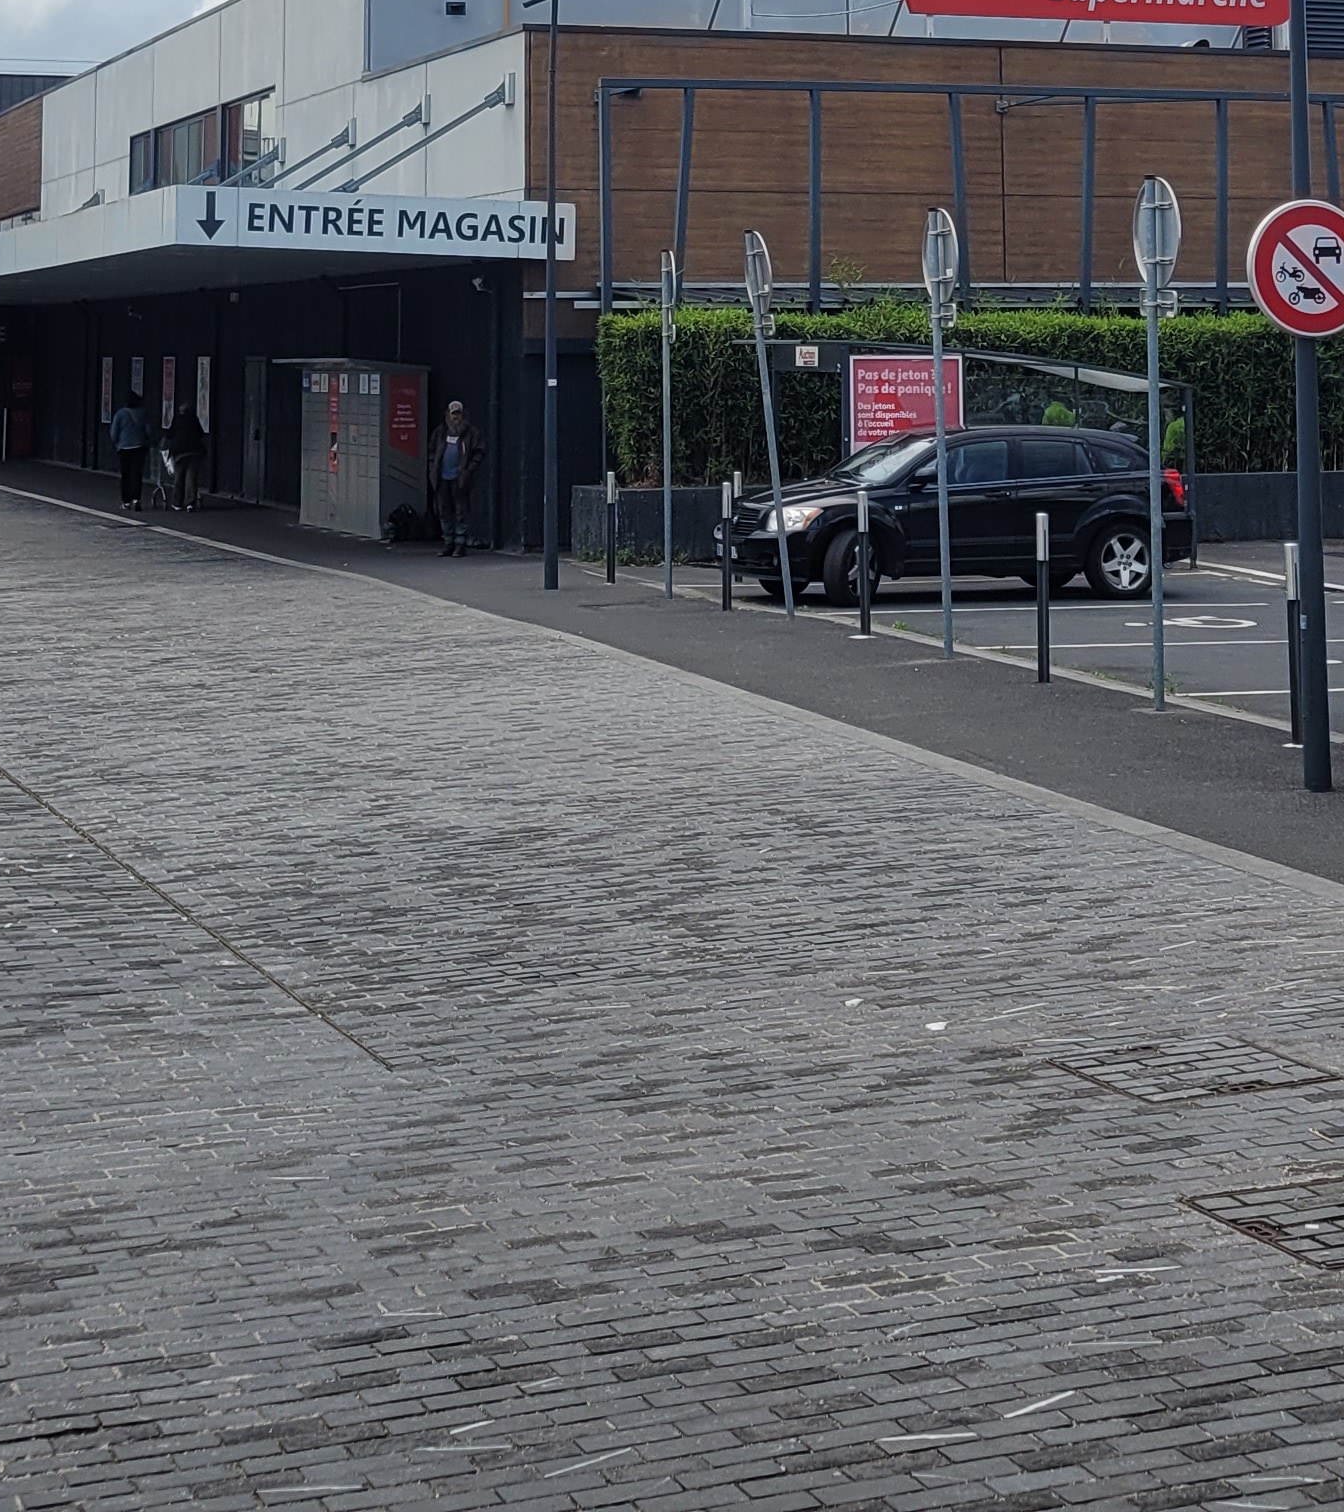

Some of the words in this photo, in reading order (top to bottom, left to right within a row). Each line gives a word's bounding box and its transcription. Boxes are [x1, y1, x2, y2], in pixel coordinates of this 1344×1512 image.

[247, 199, 385, 237] ENTRÉE
[397, 209, 565, 245] MAGASIN
[857, 369, 879, 380] Pas
[881, 369, 896, 380] de
[897, 368, 928, 383] jeton
[857, 383, 879, 394] Pas
[881, 383, 896, 394] de
[897, 382, 946, 397] paniq
[857, 402, 871, 410] Des
[872, 402, 895, 412] jetons
[875, 411, 917, 420] disponibles
